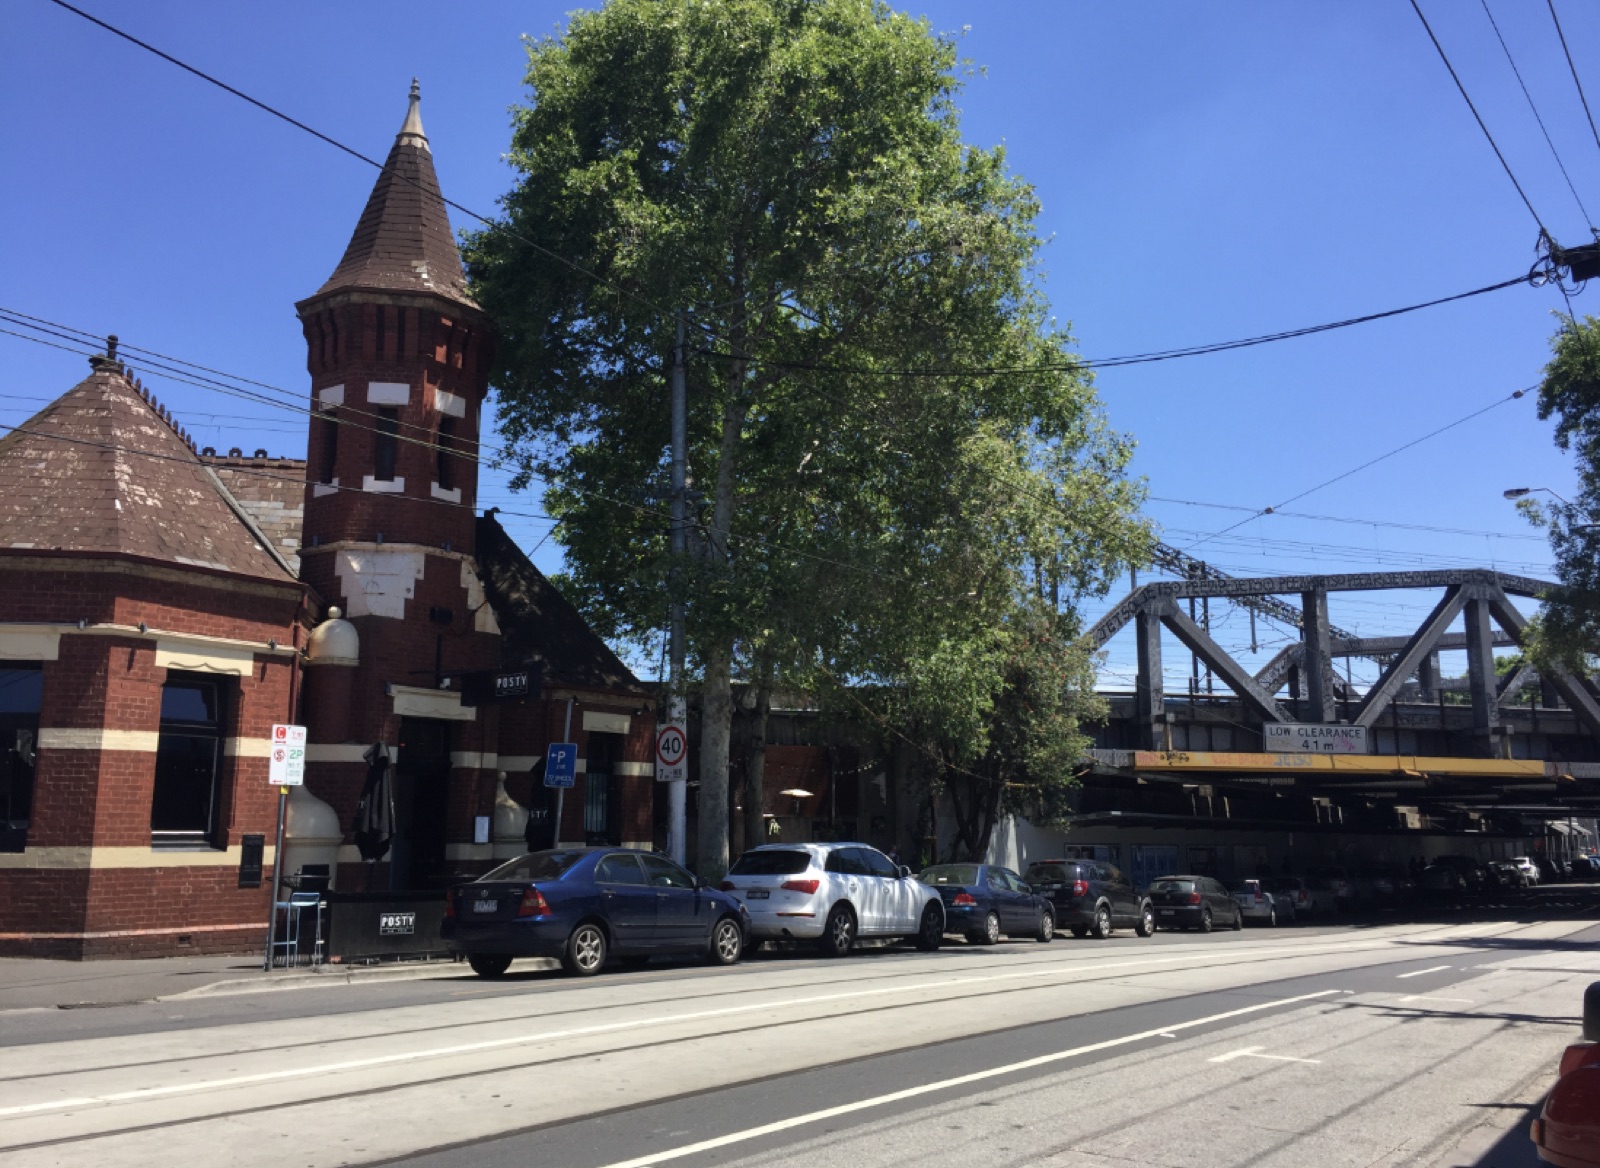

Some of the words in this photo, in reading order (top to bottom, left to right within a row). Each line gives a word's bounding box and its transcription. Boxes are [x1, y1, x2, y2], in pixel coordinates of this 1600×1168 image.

[496, 675, 527, 688] POSTY
[1270, 727, 1291, 736] LOW
[1297, 727, 1361, 739] CLEARANCE
[661, 737, 681, 754] 40
[557, 751, 566, 763] P
[381, 915, 415, 928] POSTY
